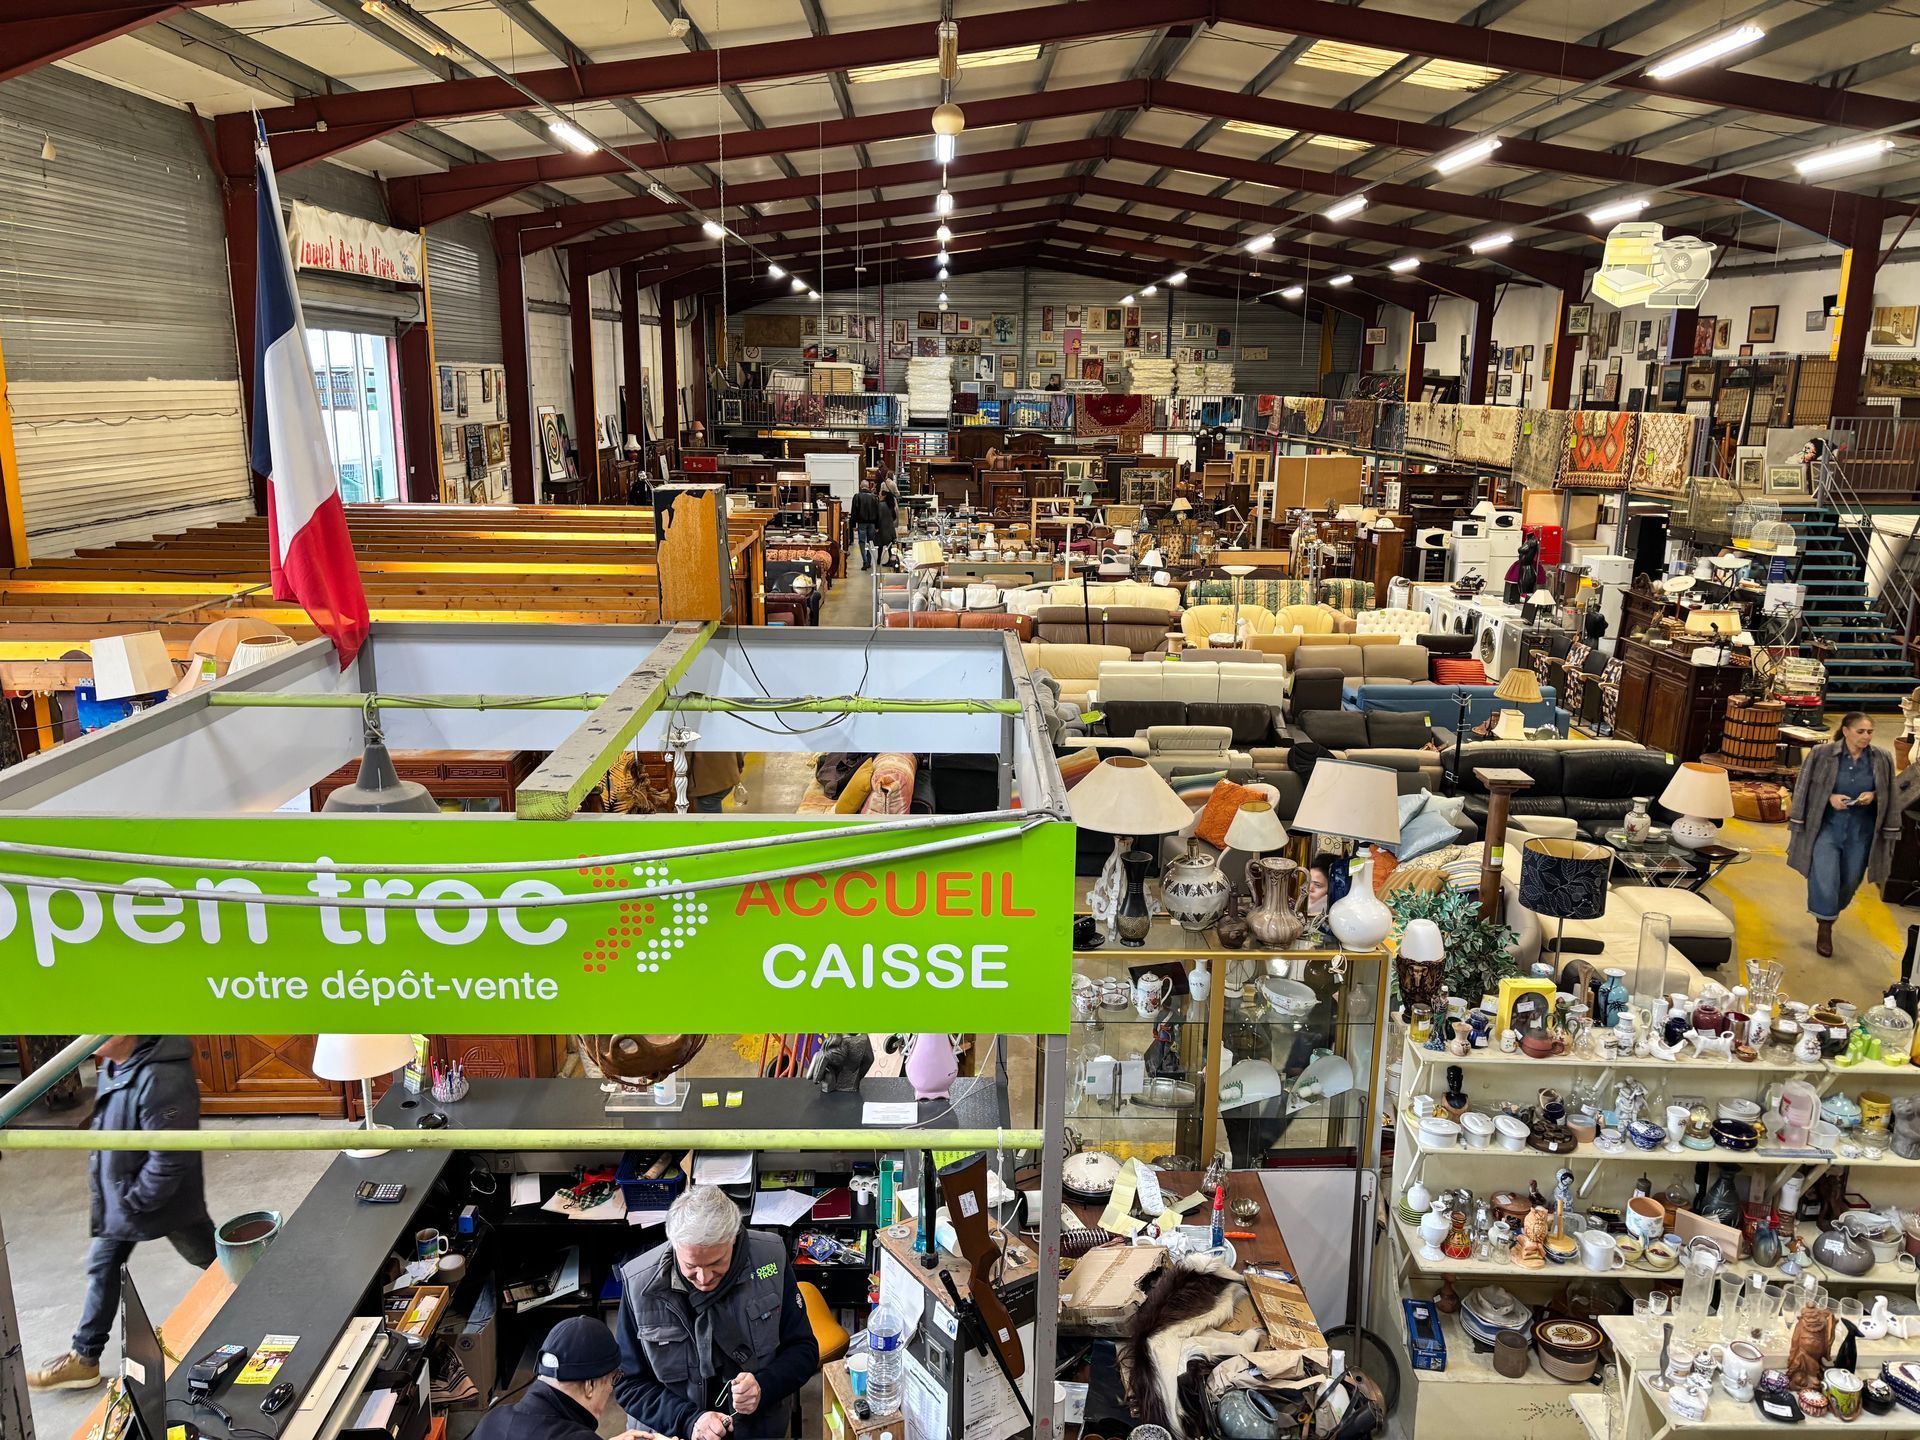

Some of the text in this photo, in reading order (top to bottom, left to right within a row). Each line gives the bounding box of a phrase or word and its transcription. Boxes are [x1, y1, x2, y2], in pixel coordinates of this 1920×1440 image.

[300, 235, 334, 268] ouvel
[339, 239, 355, 271] Art
[358, 243, 369, 274] de
[307, 856, 568, 945] troc
[734, 871, 1037, 917] ACCUEIL
[762, 943, 1009, 990] CAISSE
[206, 969, 559, 1006] votre dépôt-vente
[756, 1262, 777, 1274] OPEN
[757, 1268, 778, 1280] TROC
